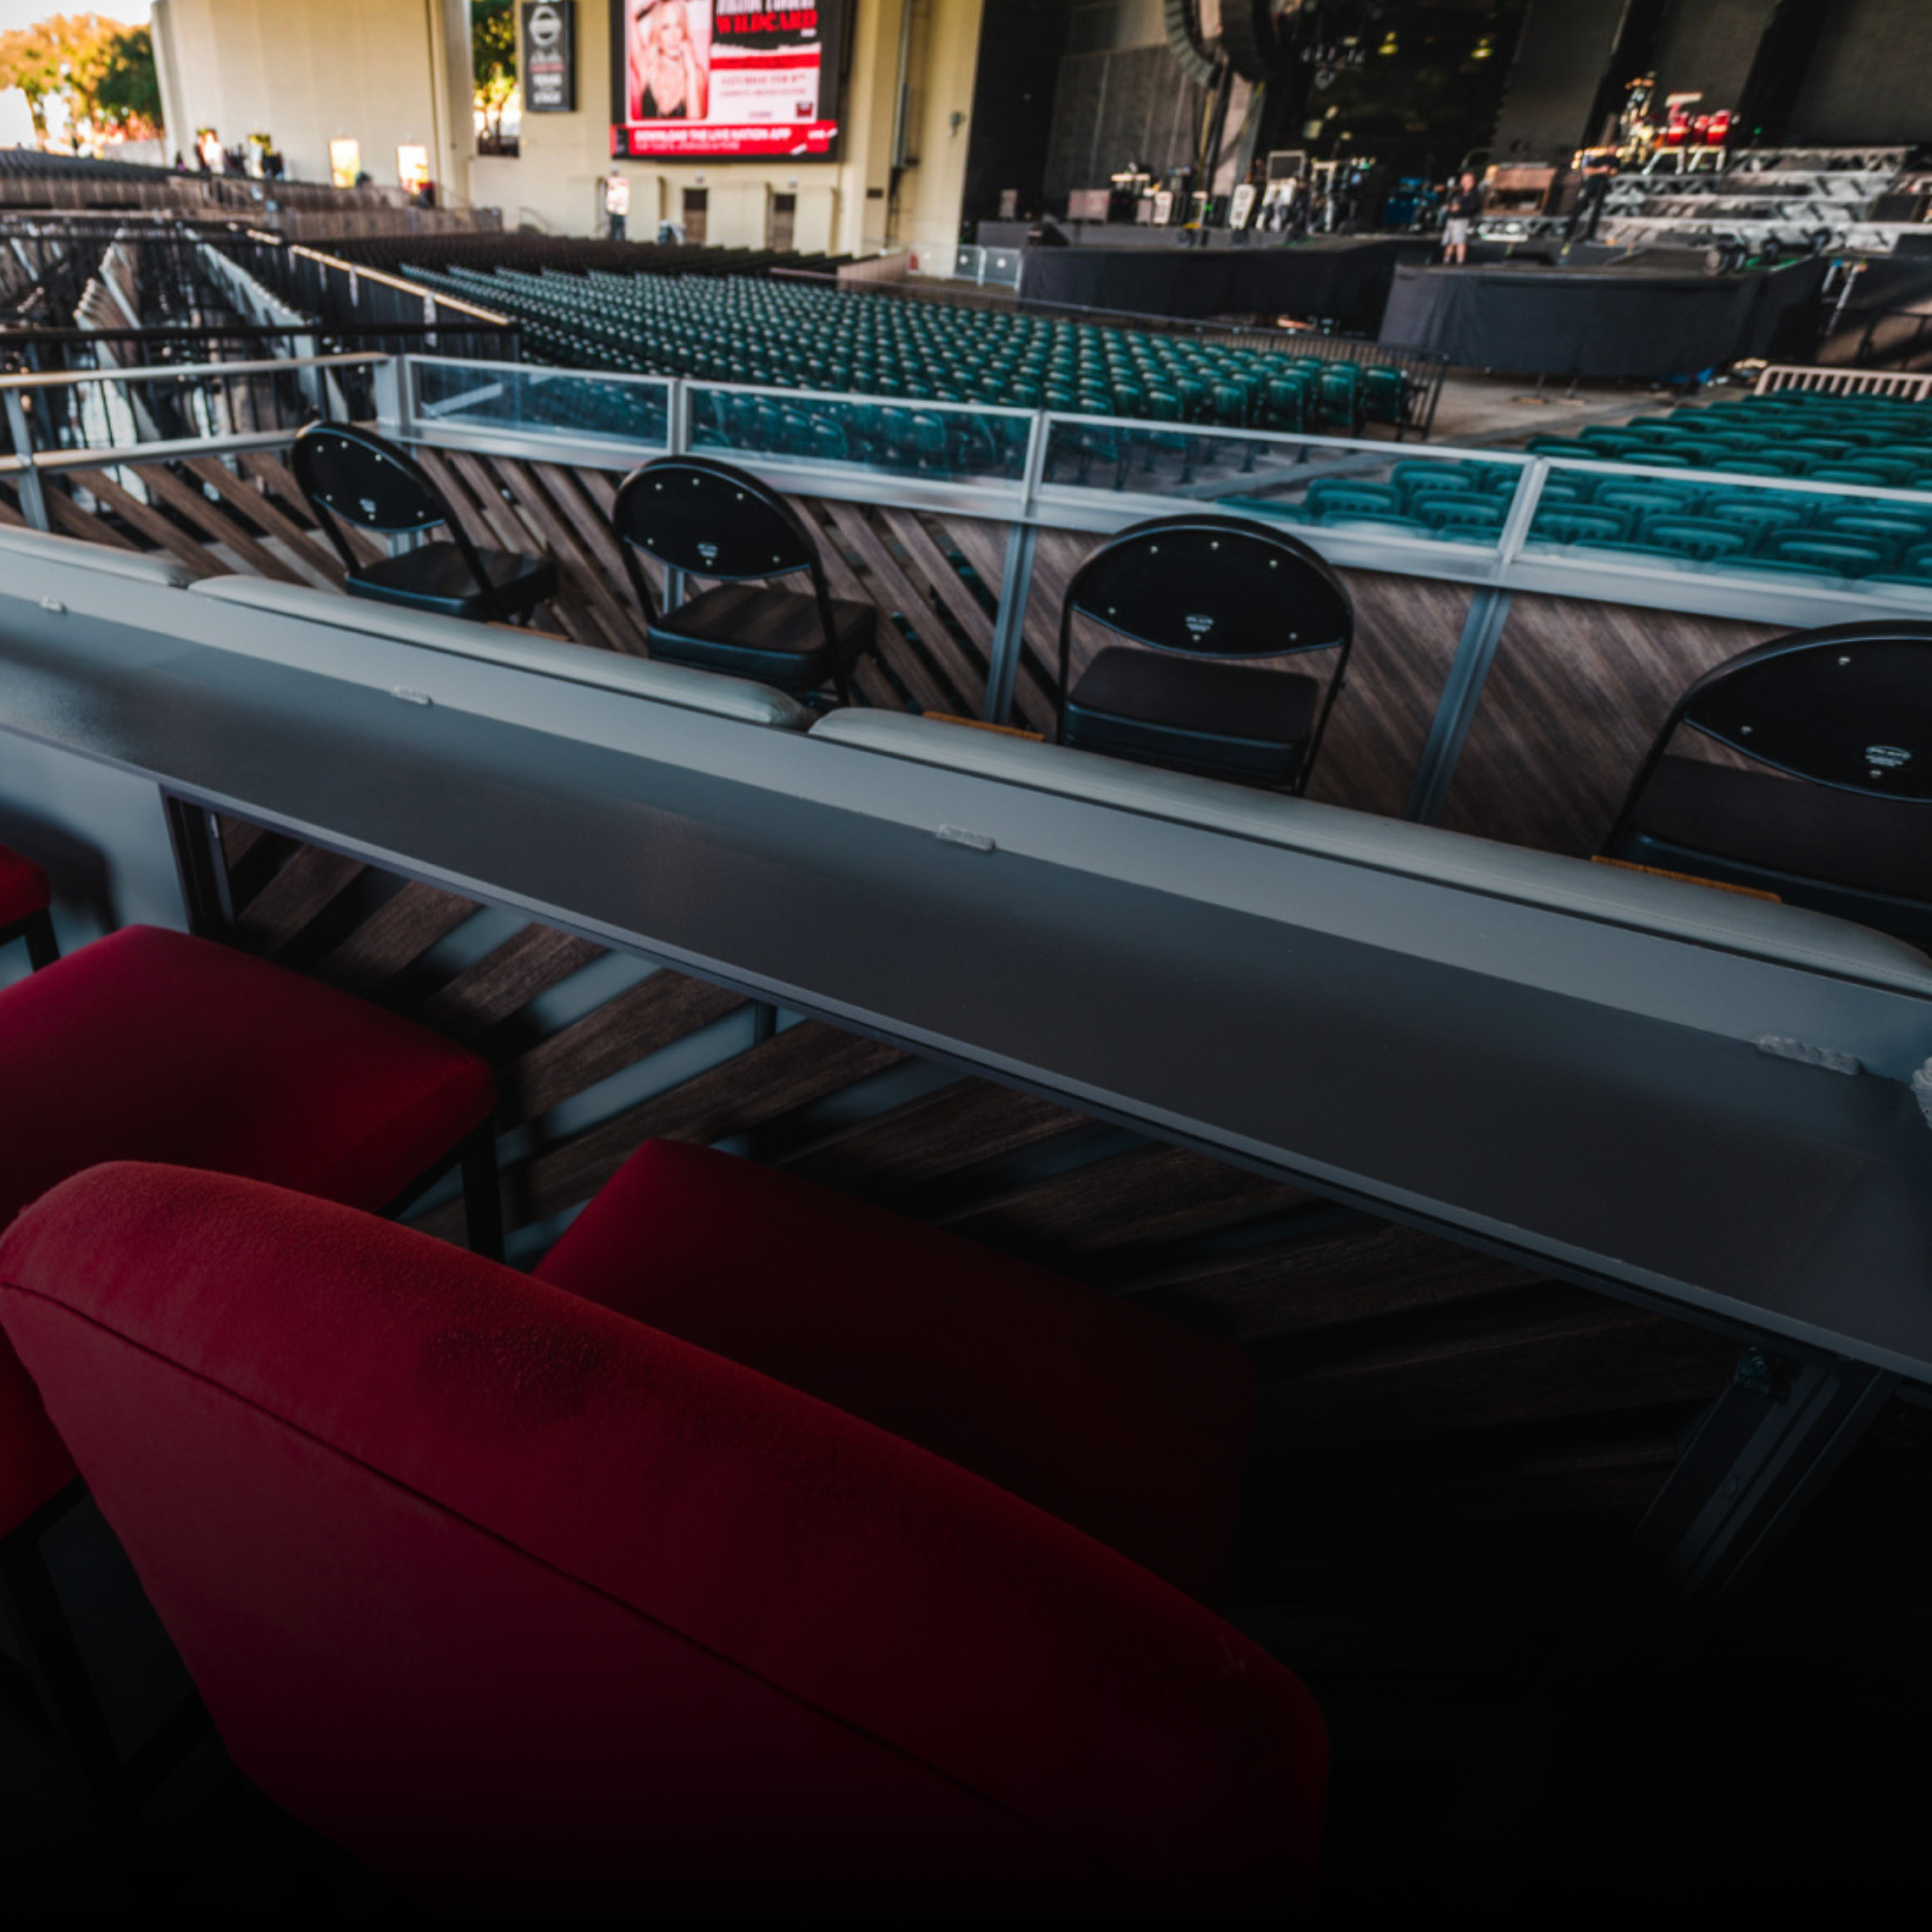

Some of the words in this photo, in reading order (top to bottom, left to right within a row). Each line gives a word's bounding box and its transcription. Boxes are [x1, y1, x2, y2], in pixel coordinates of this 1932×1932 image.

[715, 9, 818, 34] WILDCARD
[634, 129, 687, 142] DOWNLOAD
[689, 129, 707, 141] THE
